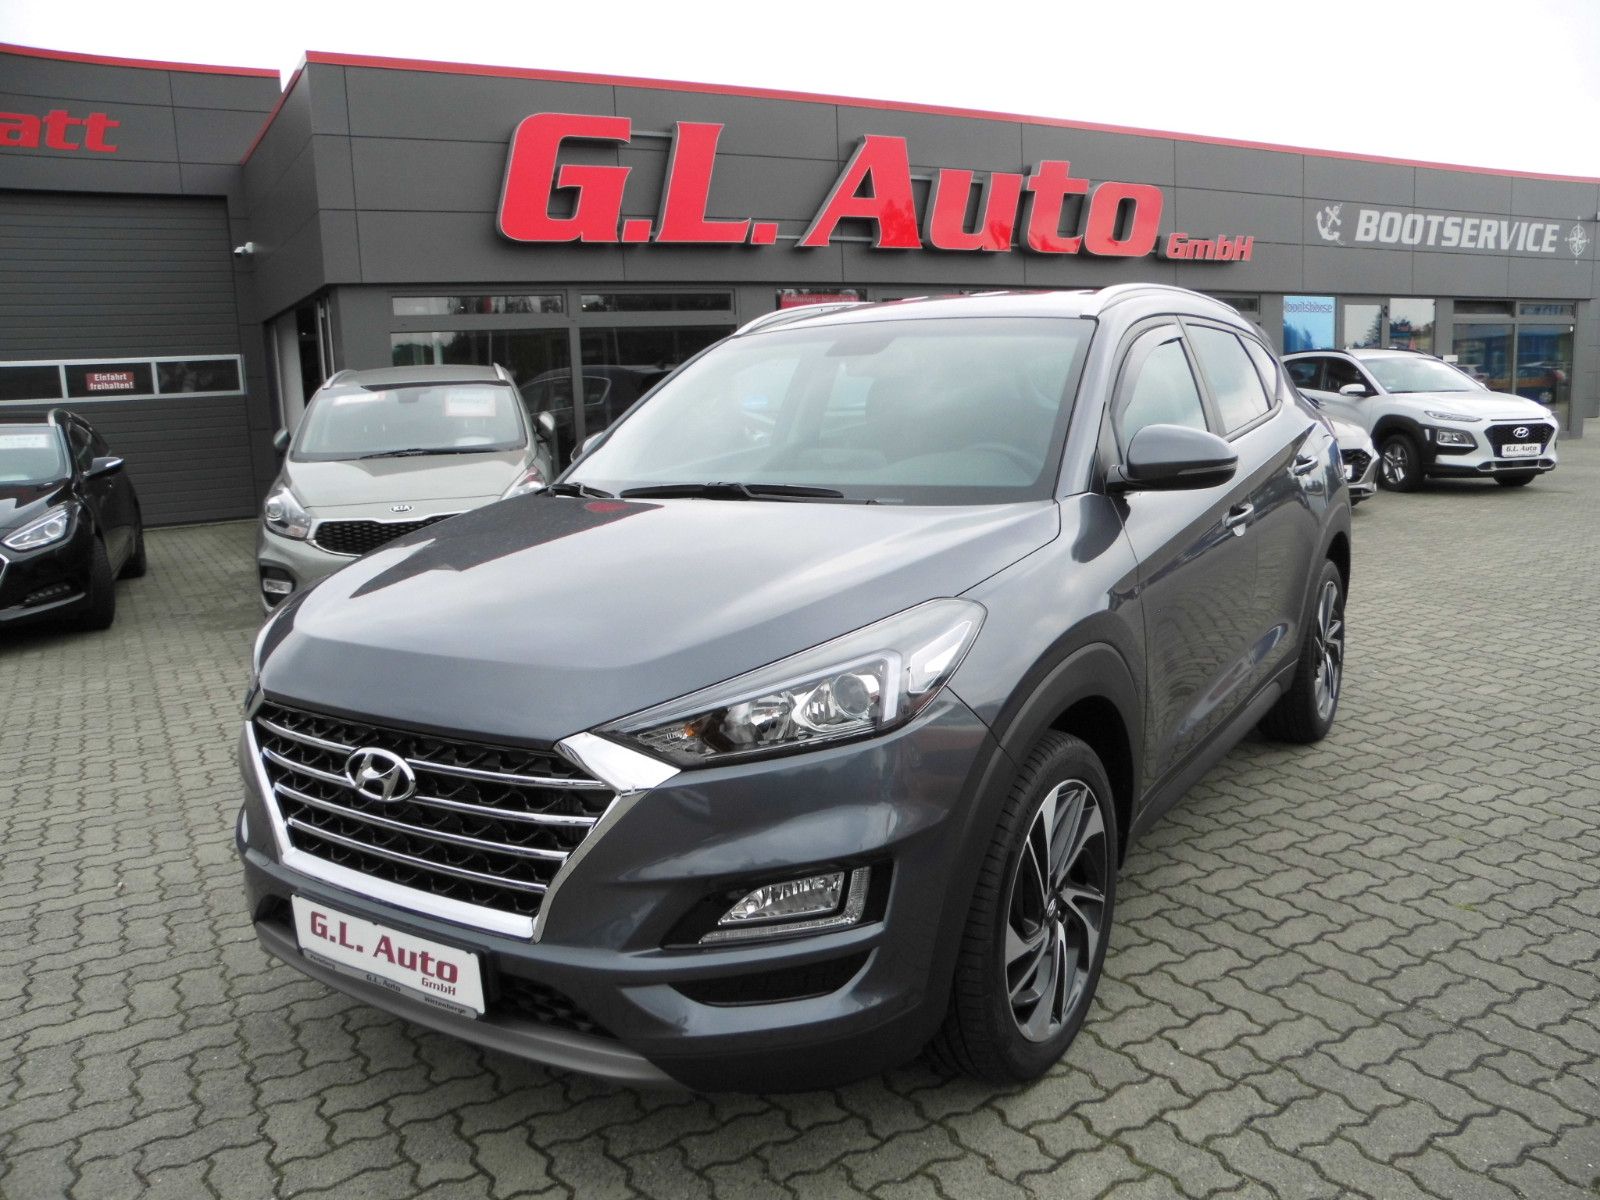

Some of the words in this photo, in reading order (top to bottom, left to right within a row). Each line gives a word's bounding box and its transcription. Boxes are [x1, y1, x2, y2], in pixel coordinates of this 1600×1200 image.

[497, 112, 778, 244] G.L.
[795, 134, 1164, 257] Auto
[1163, 232, 1254, 261] GmbH
[1355, 209, 1560, 253] BOOTSERVICE
[90, 381, 134, 390] freihalten!
[94, 373, 127, 381] Einfahrt
[310, 911, 364, 953] G.L.
[372, 935, 458, 984] Auto
[382, 979, 401, 992] Auto
[421, 977, 456, 996] GmbH
